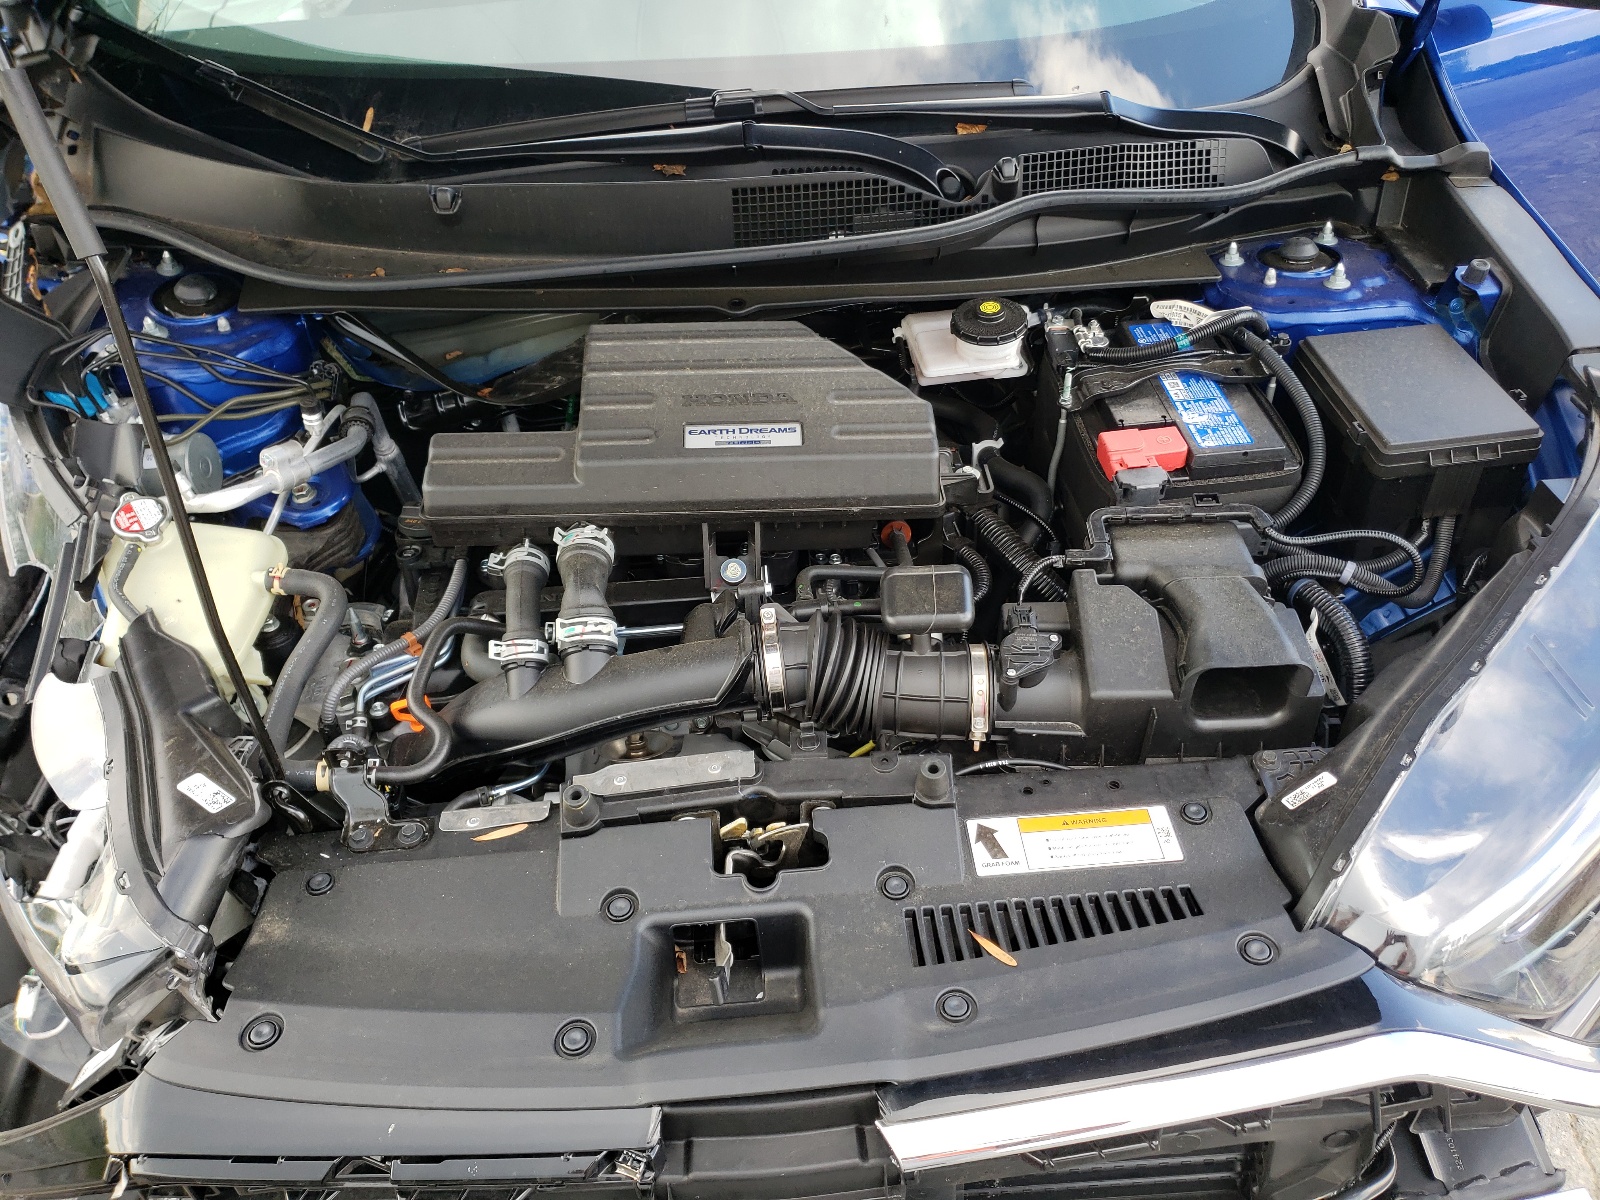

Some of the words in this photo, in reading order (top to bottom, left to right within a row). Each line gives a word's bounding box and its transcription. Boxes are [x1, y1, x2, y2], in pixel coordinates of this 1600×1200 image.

[682, 391, 798, 406] HONDA
[688, 427, 736, 435] EARTH
[1070, 817, 1107, 825] WARNING
